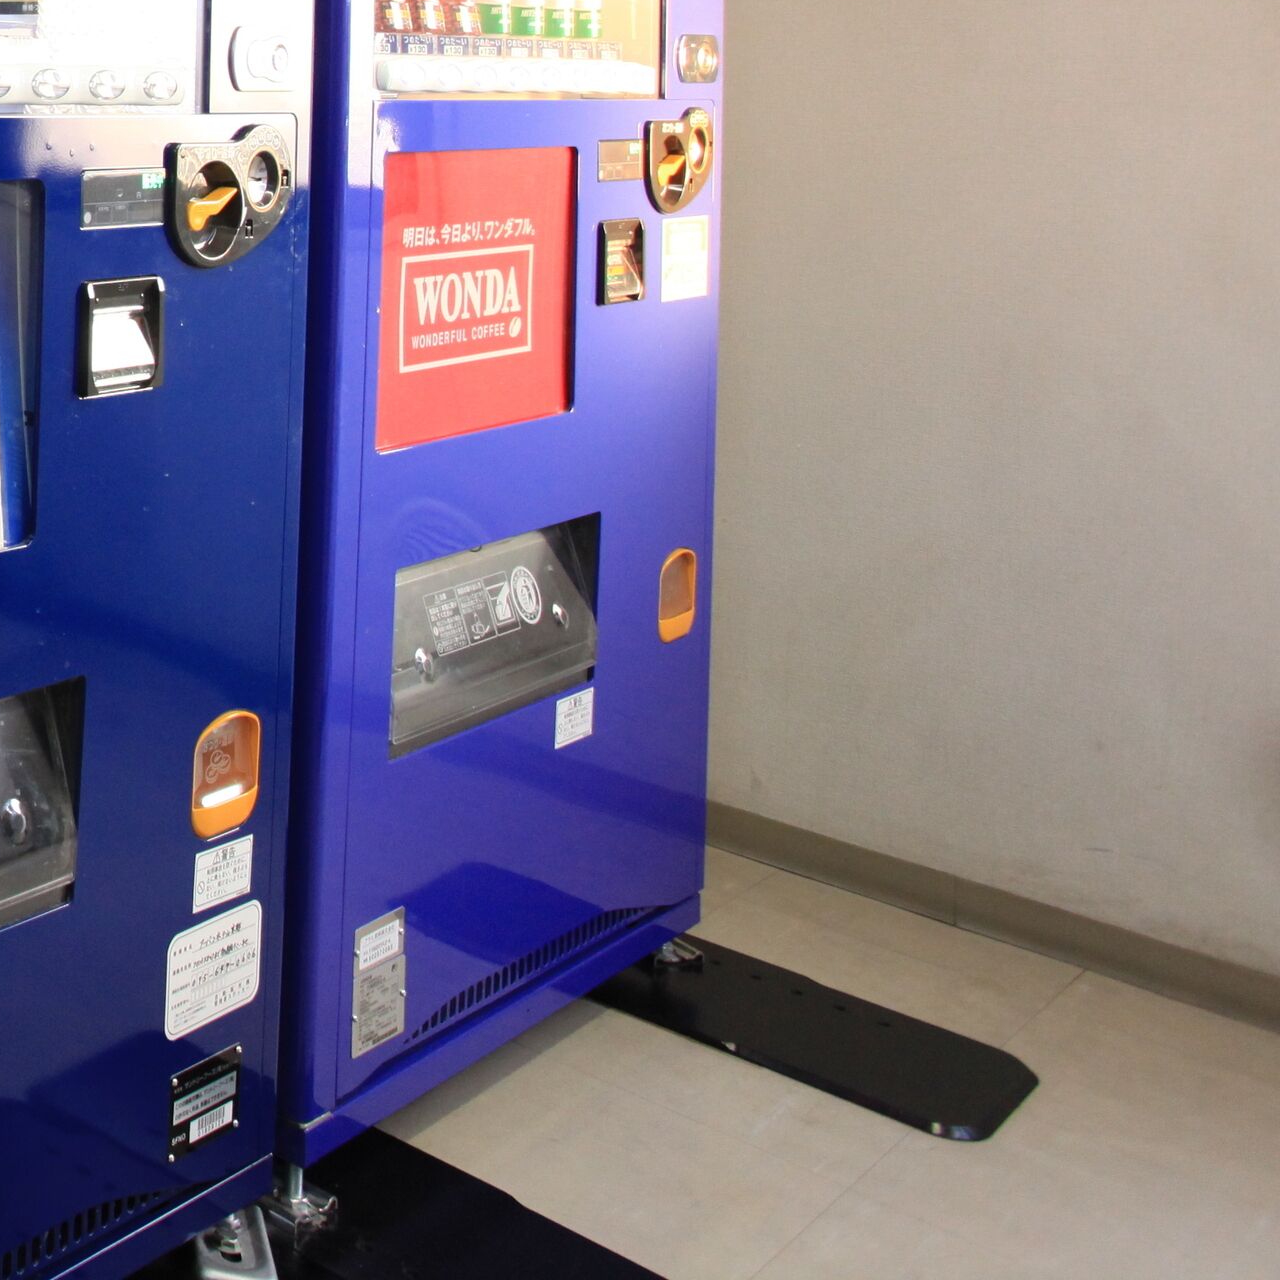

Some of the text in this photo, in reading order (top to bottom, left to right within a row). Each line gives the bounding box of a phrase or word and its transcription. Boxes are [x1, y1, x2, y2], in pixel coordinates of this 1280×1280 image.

[402, 218, 535, 248] 明日は、今日より、ワンダフル。
[413, 266, 521, 326] WONDA
[412, 322, 505, 350] WONDERFUL COFFEE
[222, 846, 235, 861] 警告
